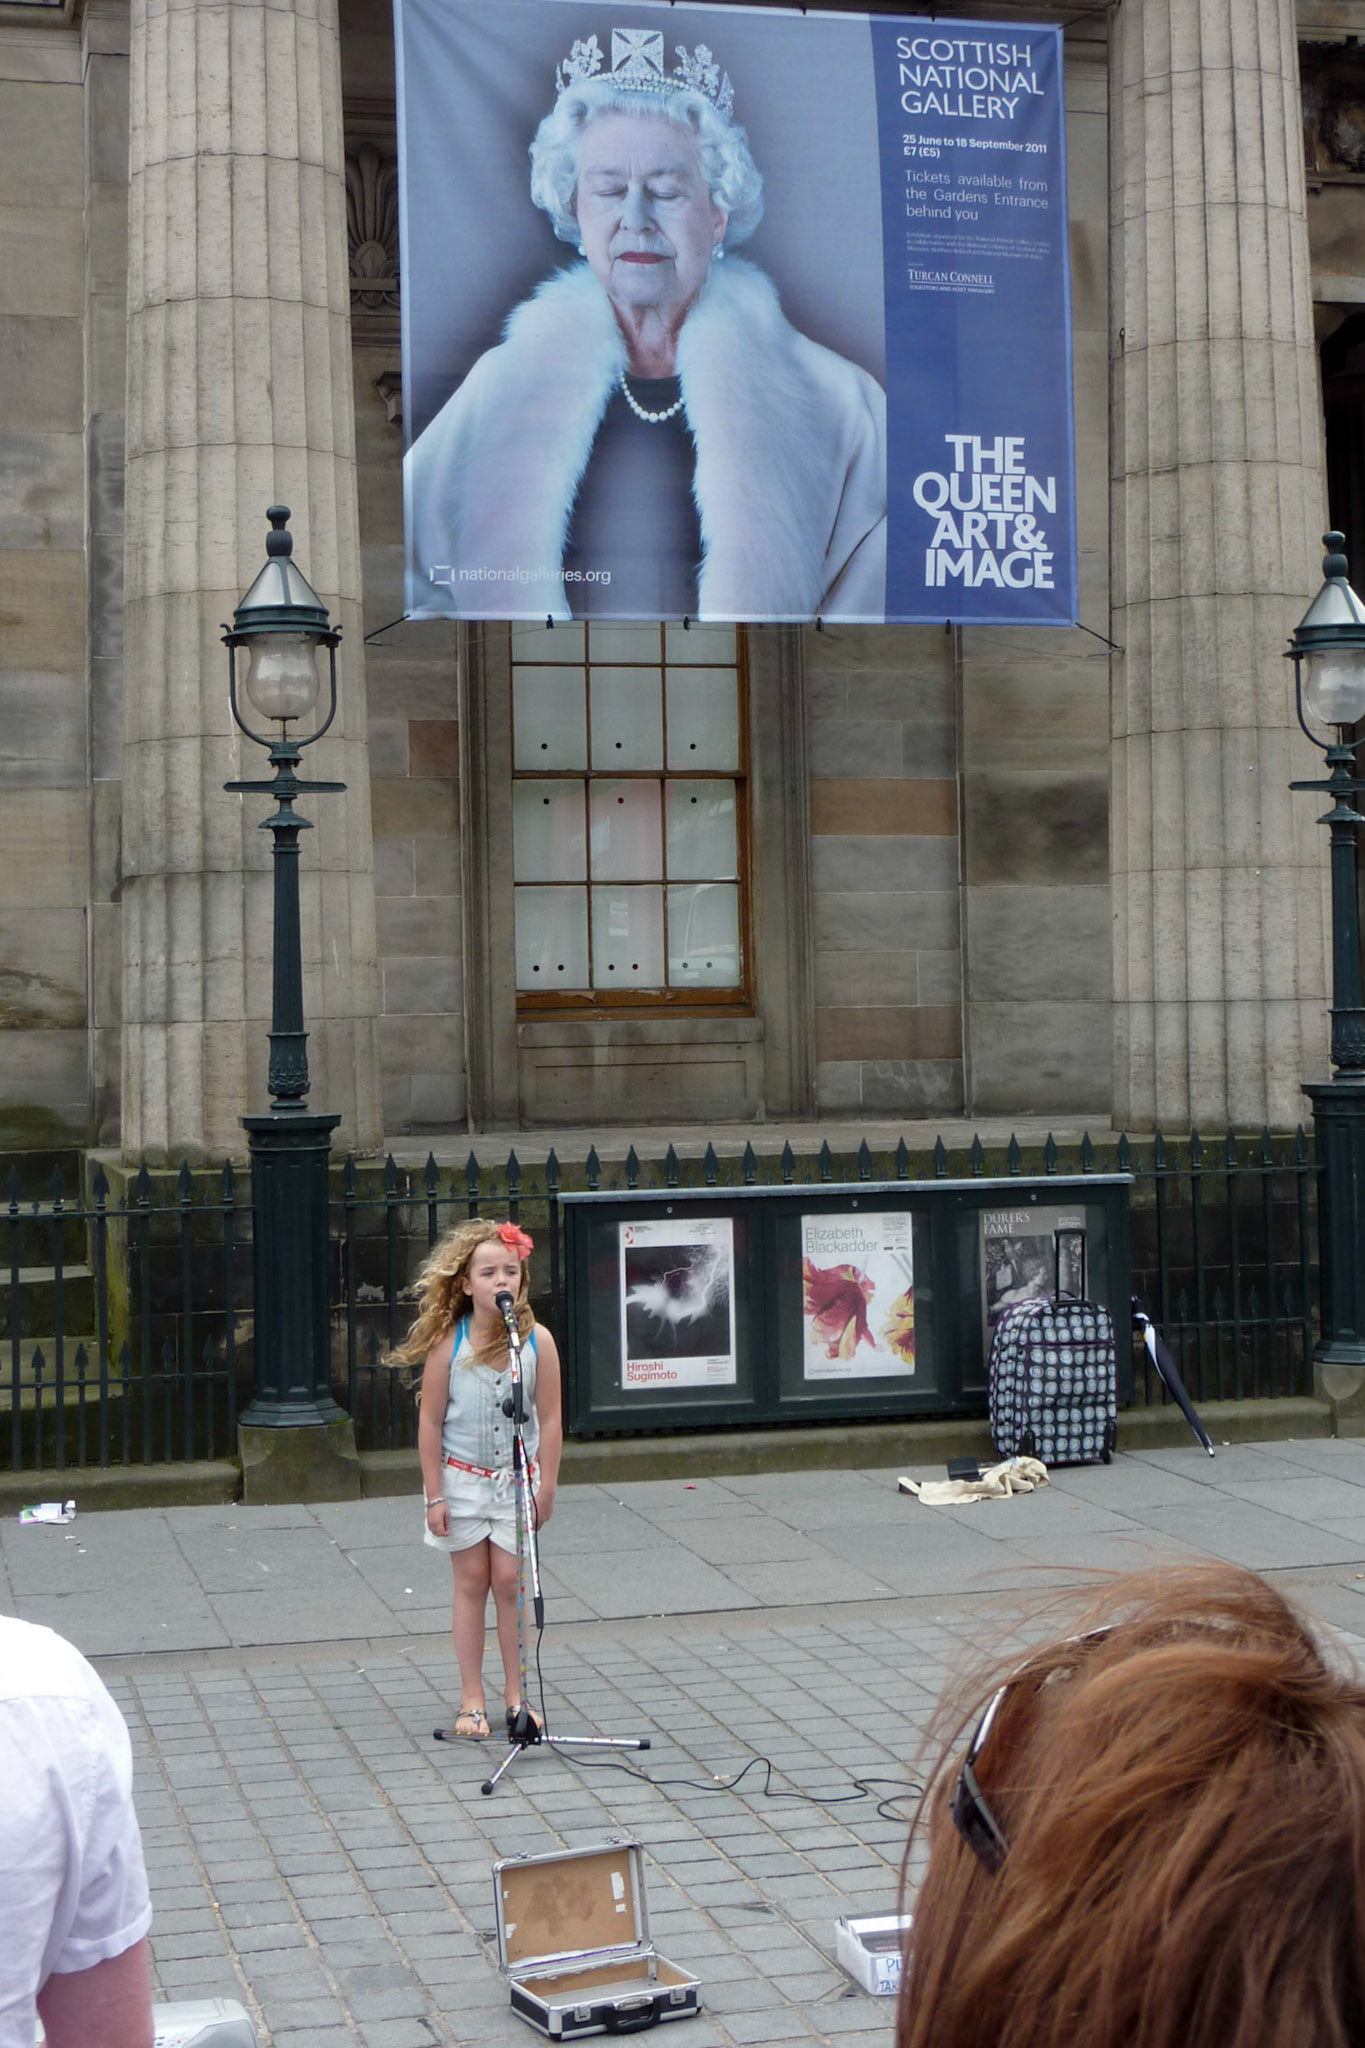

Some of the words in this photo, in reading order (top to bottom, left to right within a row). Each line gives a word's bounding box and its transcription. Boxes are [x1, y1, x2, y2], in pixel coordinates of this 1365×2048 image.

[896, 37, 1032, 68] SCOTTISH
[899, 63, 1045, 96] NATIONAL
[901, 91, 1019, 119] GALLERY
[902, 134, 916, 145] 25
[918, 136, 942, 146] June
[943, 137, 954, 147] to
[955, 138, 968, 148] 18
[969, 138, 1024, 152] September
[1025, 143, 1047, 154] 2011
[903, 146, 916, 156] £7
[918, 147, 941, 159] (£5)
[905, 169, 951, 185] Tickets
[957, 173, 1012, 189] available
[1019, 176, 1048, 192] from
[905, 187, 927, 200] the
[933, 188, 988, 204] Gardens
[994, 193, 1049, 209] Entrance
[906, 203, 951, 219] behind
[954, 210, 979, 222] you
[907, 269, 948, 282] TURCAN
[949, 271, 995, 285] CONNELL
[945, 434, 1026, 474] THE
[912, 471, 1056, 518] QUEEN
[930, 511, 1048, 551] ART&
[459, 566, 612, 586] nationalgalleries.org
[925, 548, 1055, 589] IMAGE
[805, 1227, 863, 1240] Elizabeth
[984, 1223, 1014, 1235] FAME
[805, 1240, 879, 1254] Blackadder
[626, 1361, 664, 1372] Hiroshi
[626, 1370, 678, 1383] Sugimoto
[886, 1958, 901, 1973] PL
[880, 1980, 897, 1993] TAK
